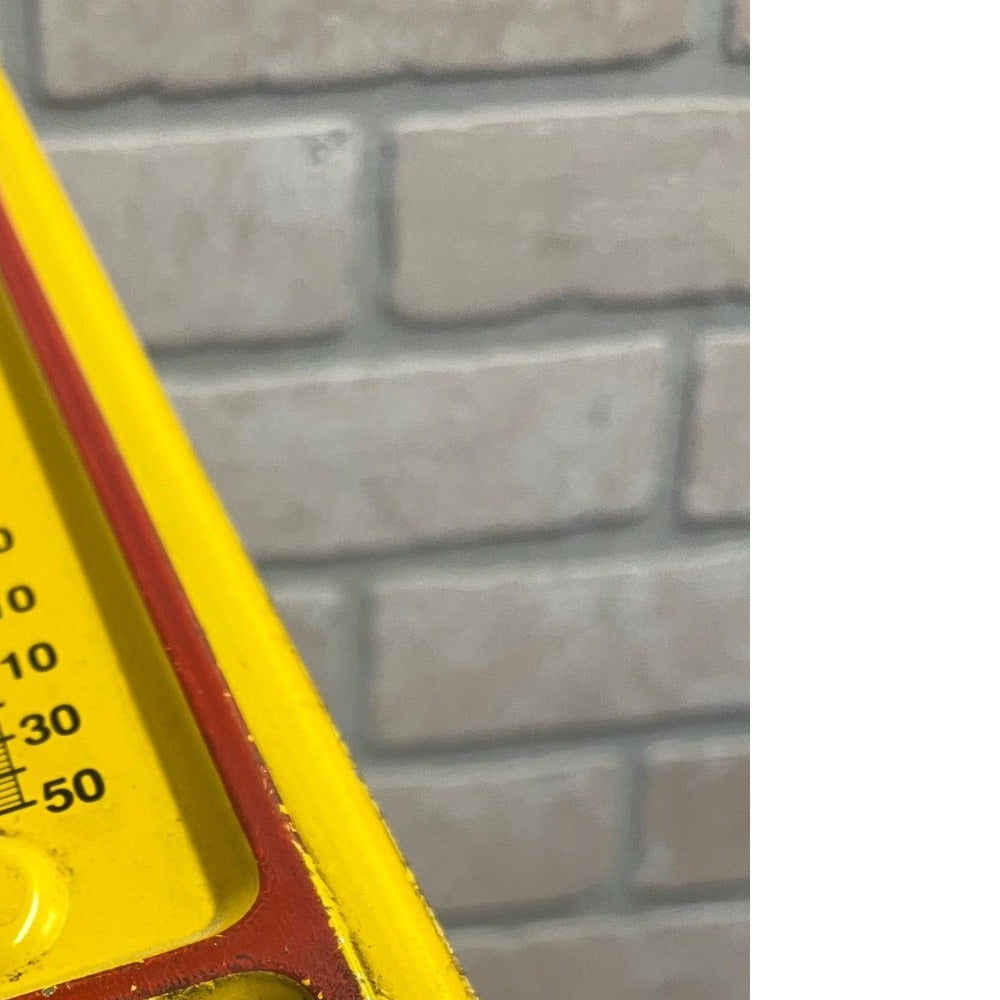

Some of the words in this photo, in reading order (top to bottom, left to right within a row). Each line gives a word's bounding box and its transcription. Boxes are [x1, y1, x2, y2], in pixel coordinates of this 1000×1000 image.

[0, 641, 58, 680] 10
[19, 703, 81, 746] 30
[43, 767, 106, 813] 50
